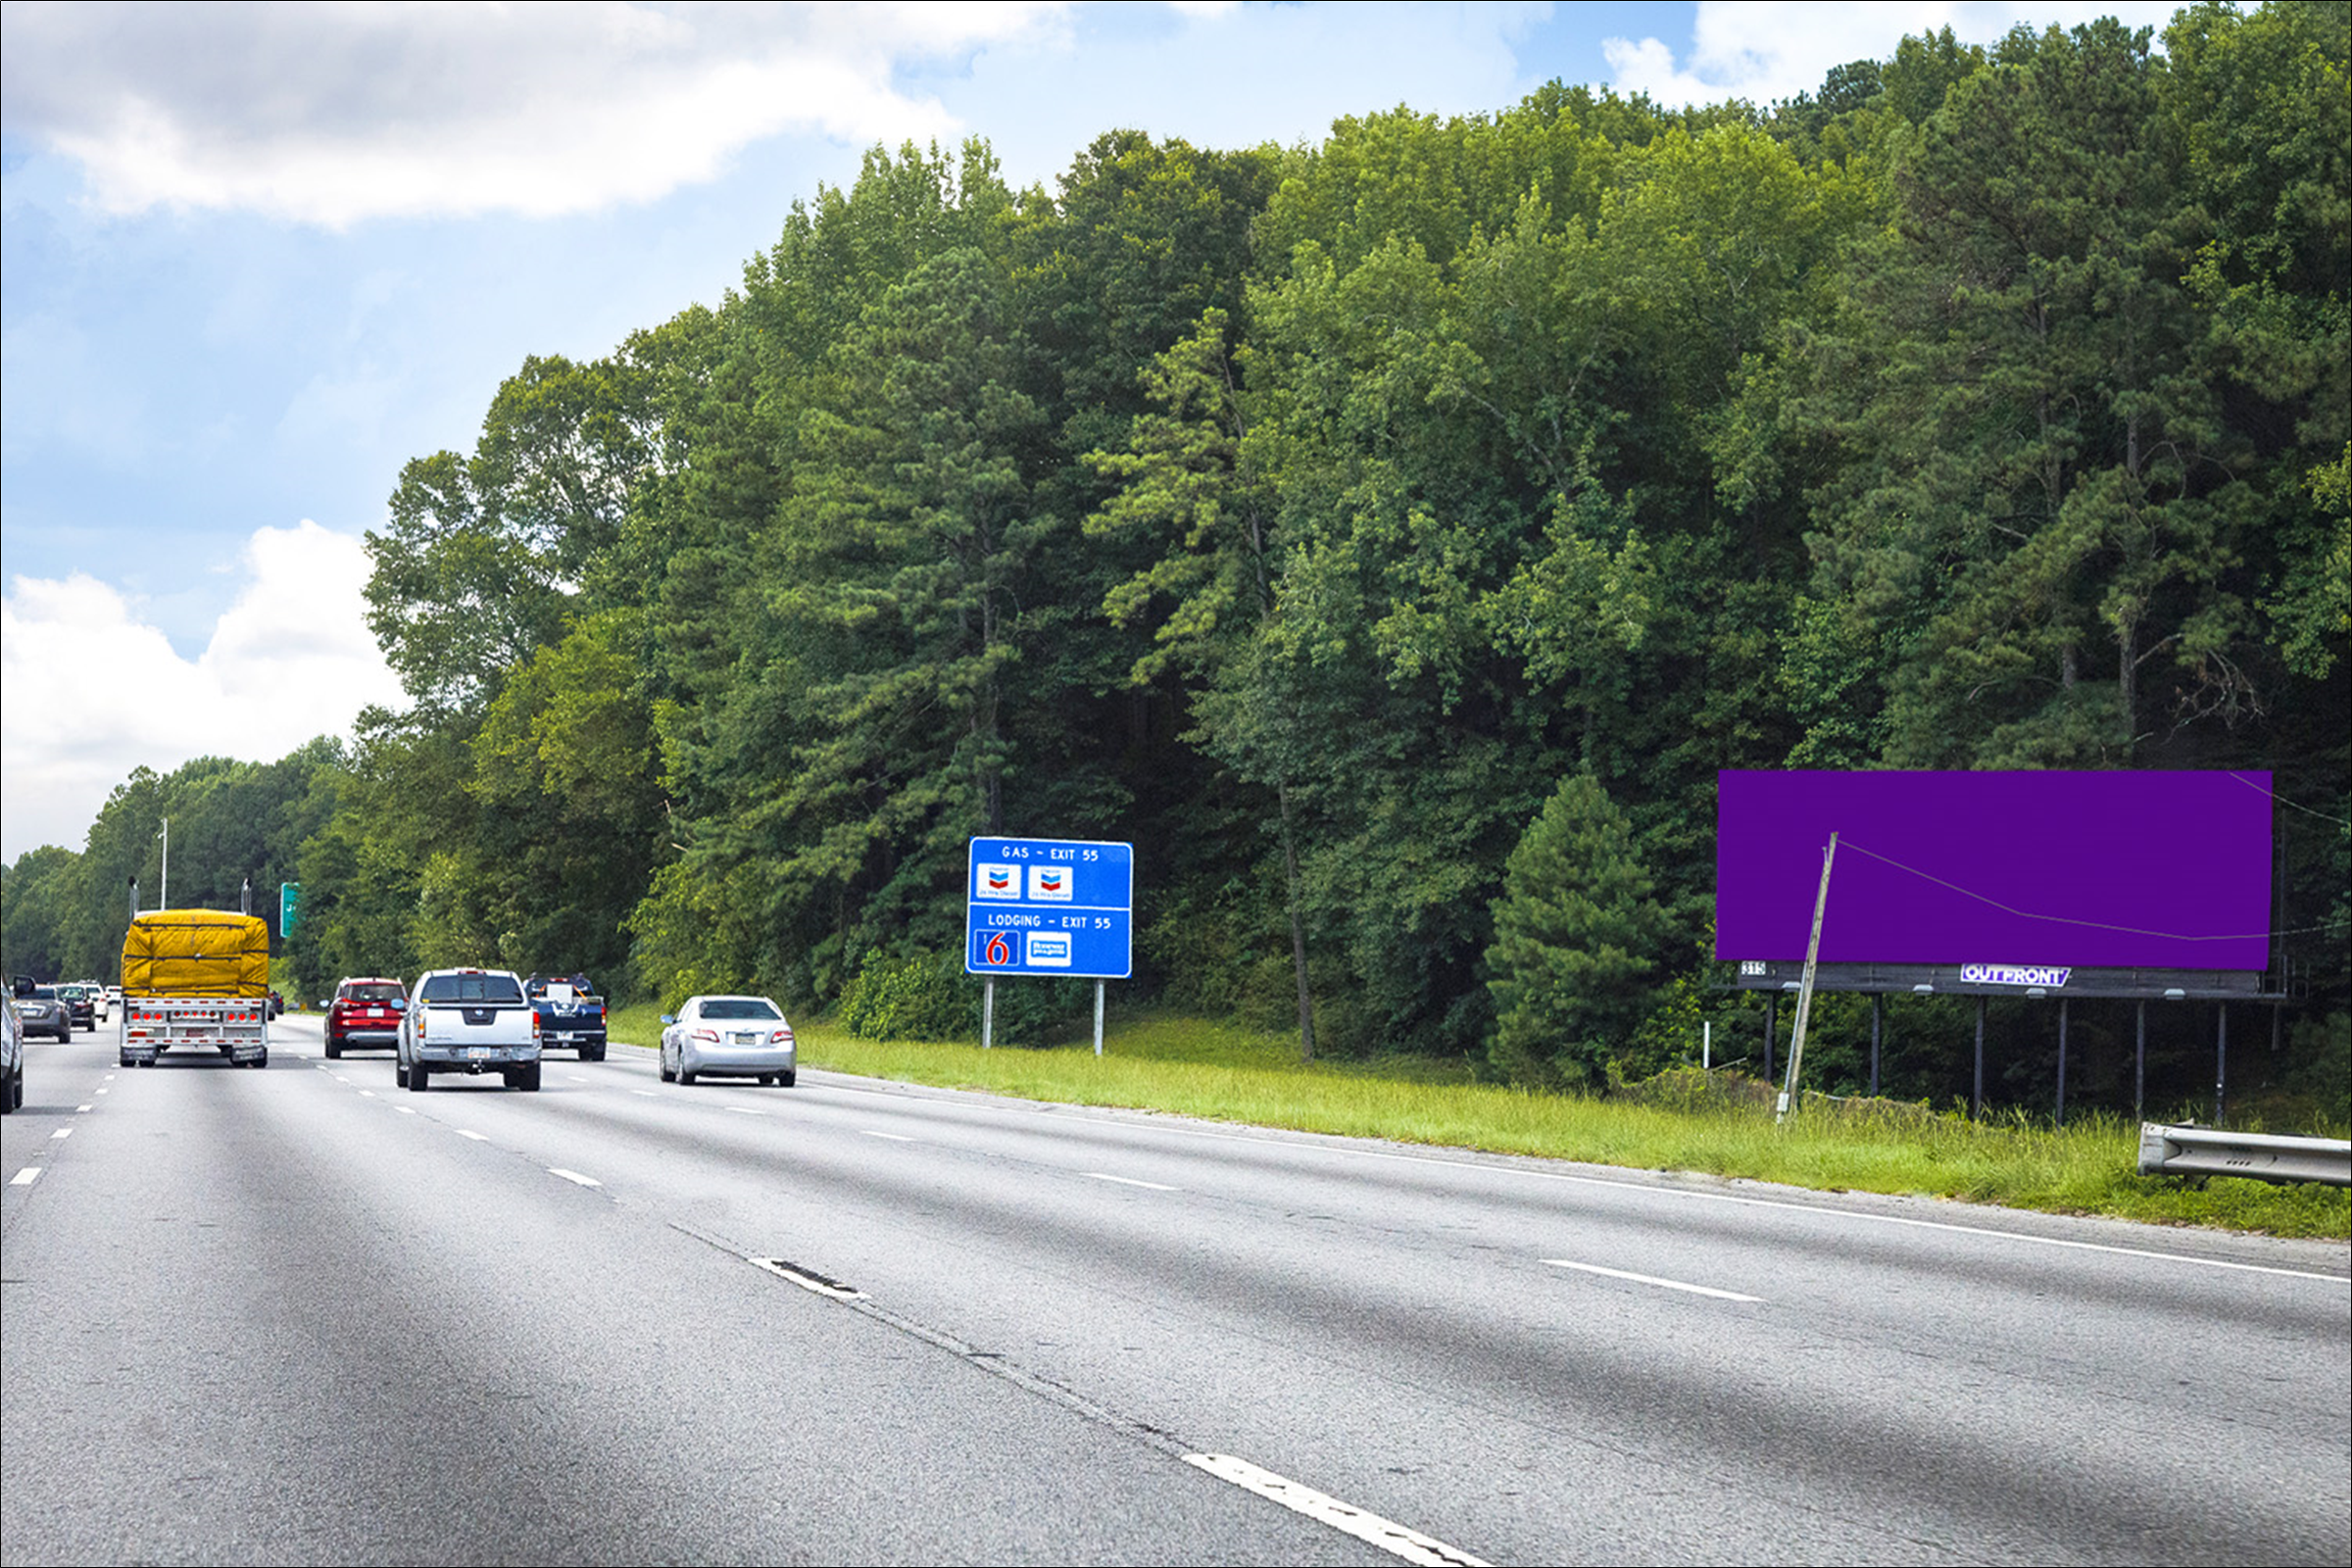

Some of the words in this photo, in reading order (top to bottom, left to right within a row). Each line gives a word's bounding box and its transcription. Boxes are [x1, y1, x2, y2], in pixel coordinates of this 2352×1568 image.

[1002, 846, 1029, 858] GAS
[1051, 849, 1075, 860] EXIT
[1083, 850, 1099, 861] 55
[988, 913, 1041, 927] LODGING
[1061, 916, 1088, 928] EXIT
[1095, 917, 1111, 929] 55
[986, 931, 1009, 965] 6
